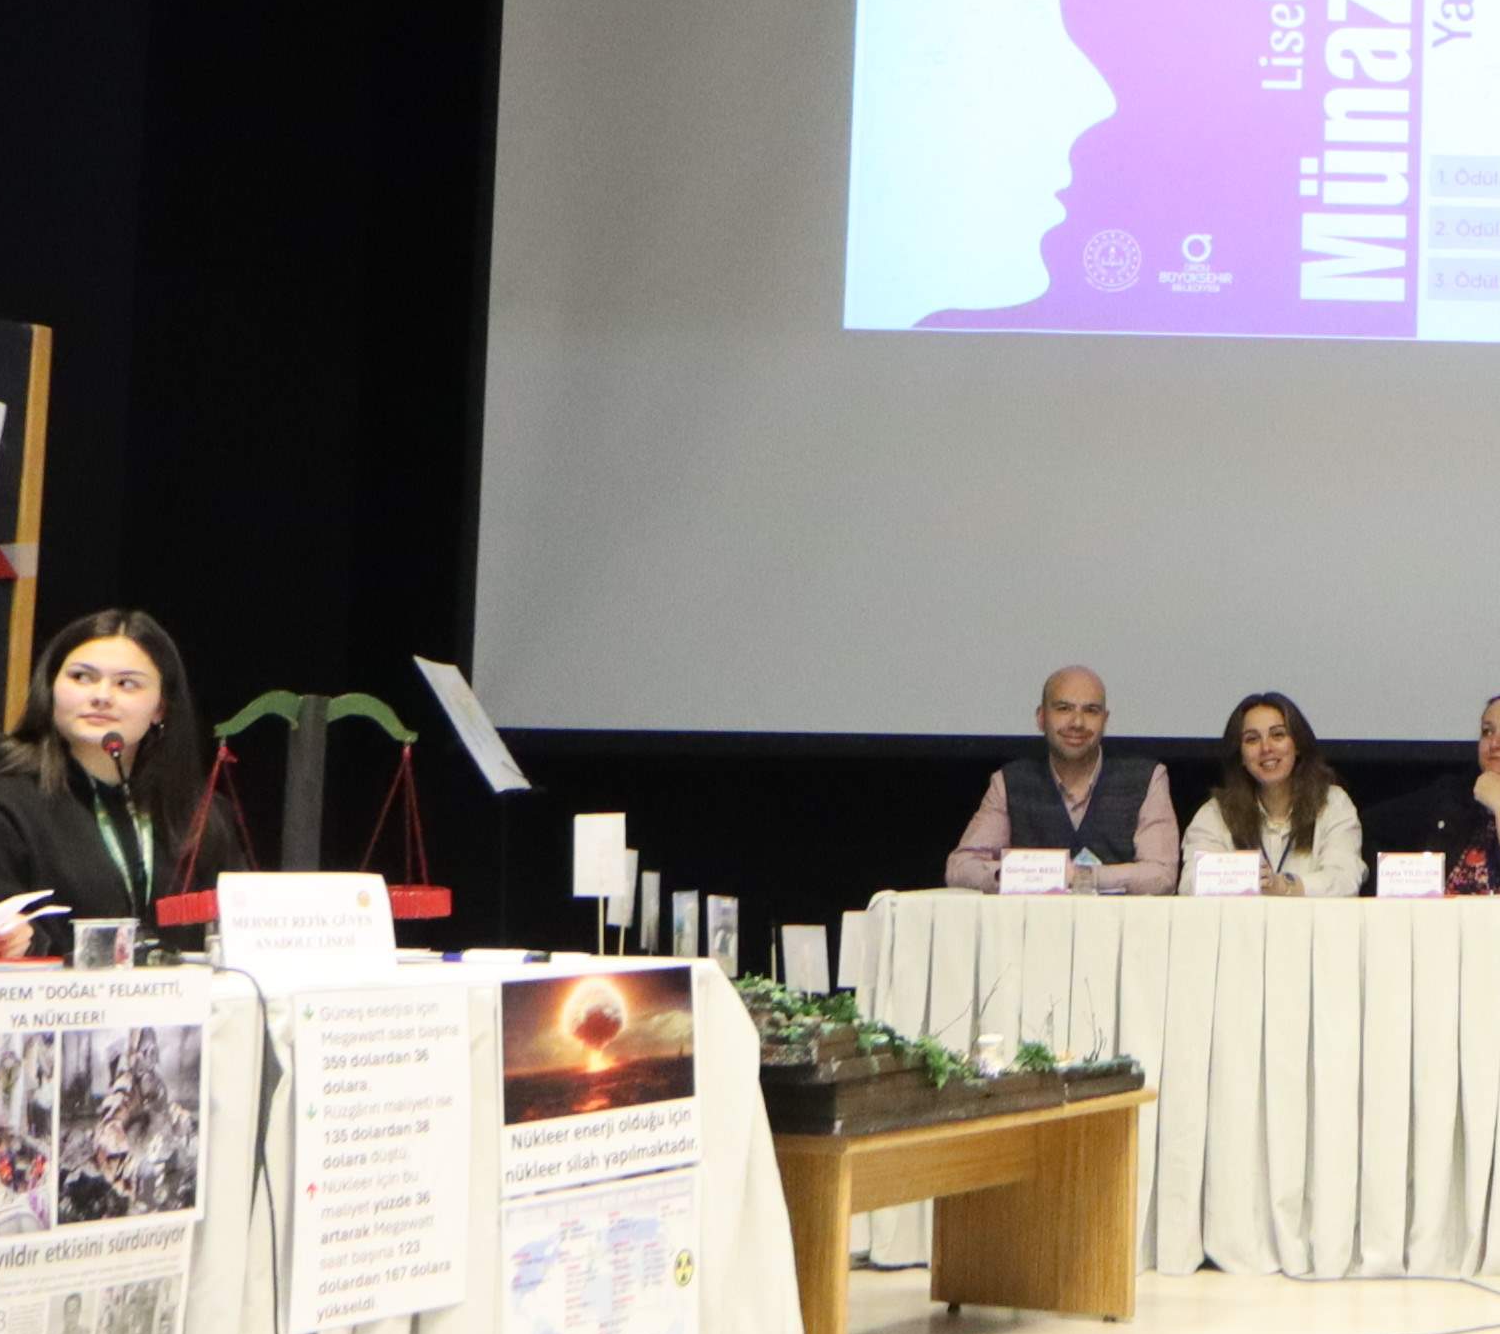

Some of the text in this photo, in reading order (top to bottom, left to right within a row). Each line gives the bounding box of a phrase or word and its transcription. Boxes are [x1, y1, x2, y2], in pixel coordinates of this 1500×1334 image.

[1454, 167, 1499, 187] Ödül
[1455, 219, 1500, 238] Ödül
[1455, 270, 1500, 290] Ödül
[38, 981, 105, 1000] "DOĞAL"
[10, 1010, 106, 1029] YA NÜKLEER!
[319, 1005, 364, 1023] Güneş
[416, 1001, 439, 1017] için
[321, 1029, 386, 1048] Megawatt
[322, 1053, 348, 1071] 359
[350, 1050, 412, 1069] dolardan
[324, 1127, 349, 1146] 135
[350, 1122, 412, 1142] dolardan
[510, 1107, 692, 1151] Nükleer enerji olduğu için
[322, 1151, 368, 1170] dolara
[504, 1135, 700, 1185] nükleer silah yapılmaktadır.
[320, 1199, 371, 1220] maliyet
[373, 1194, 412, 1215] yüzde
[45, 1237, 102, 1264] etkisini
[107, 1225, 187, 1255] sürdürüyor
[320, 1223, 371, 1246] artarak
[397, 1239, 421, 1257] 123
[317, 1259, 452, 1296] dolardan 167 dolara
